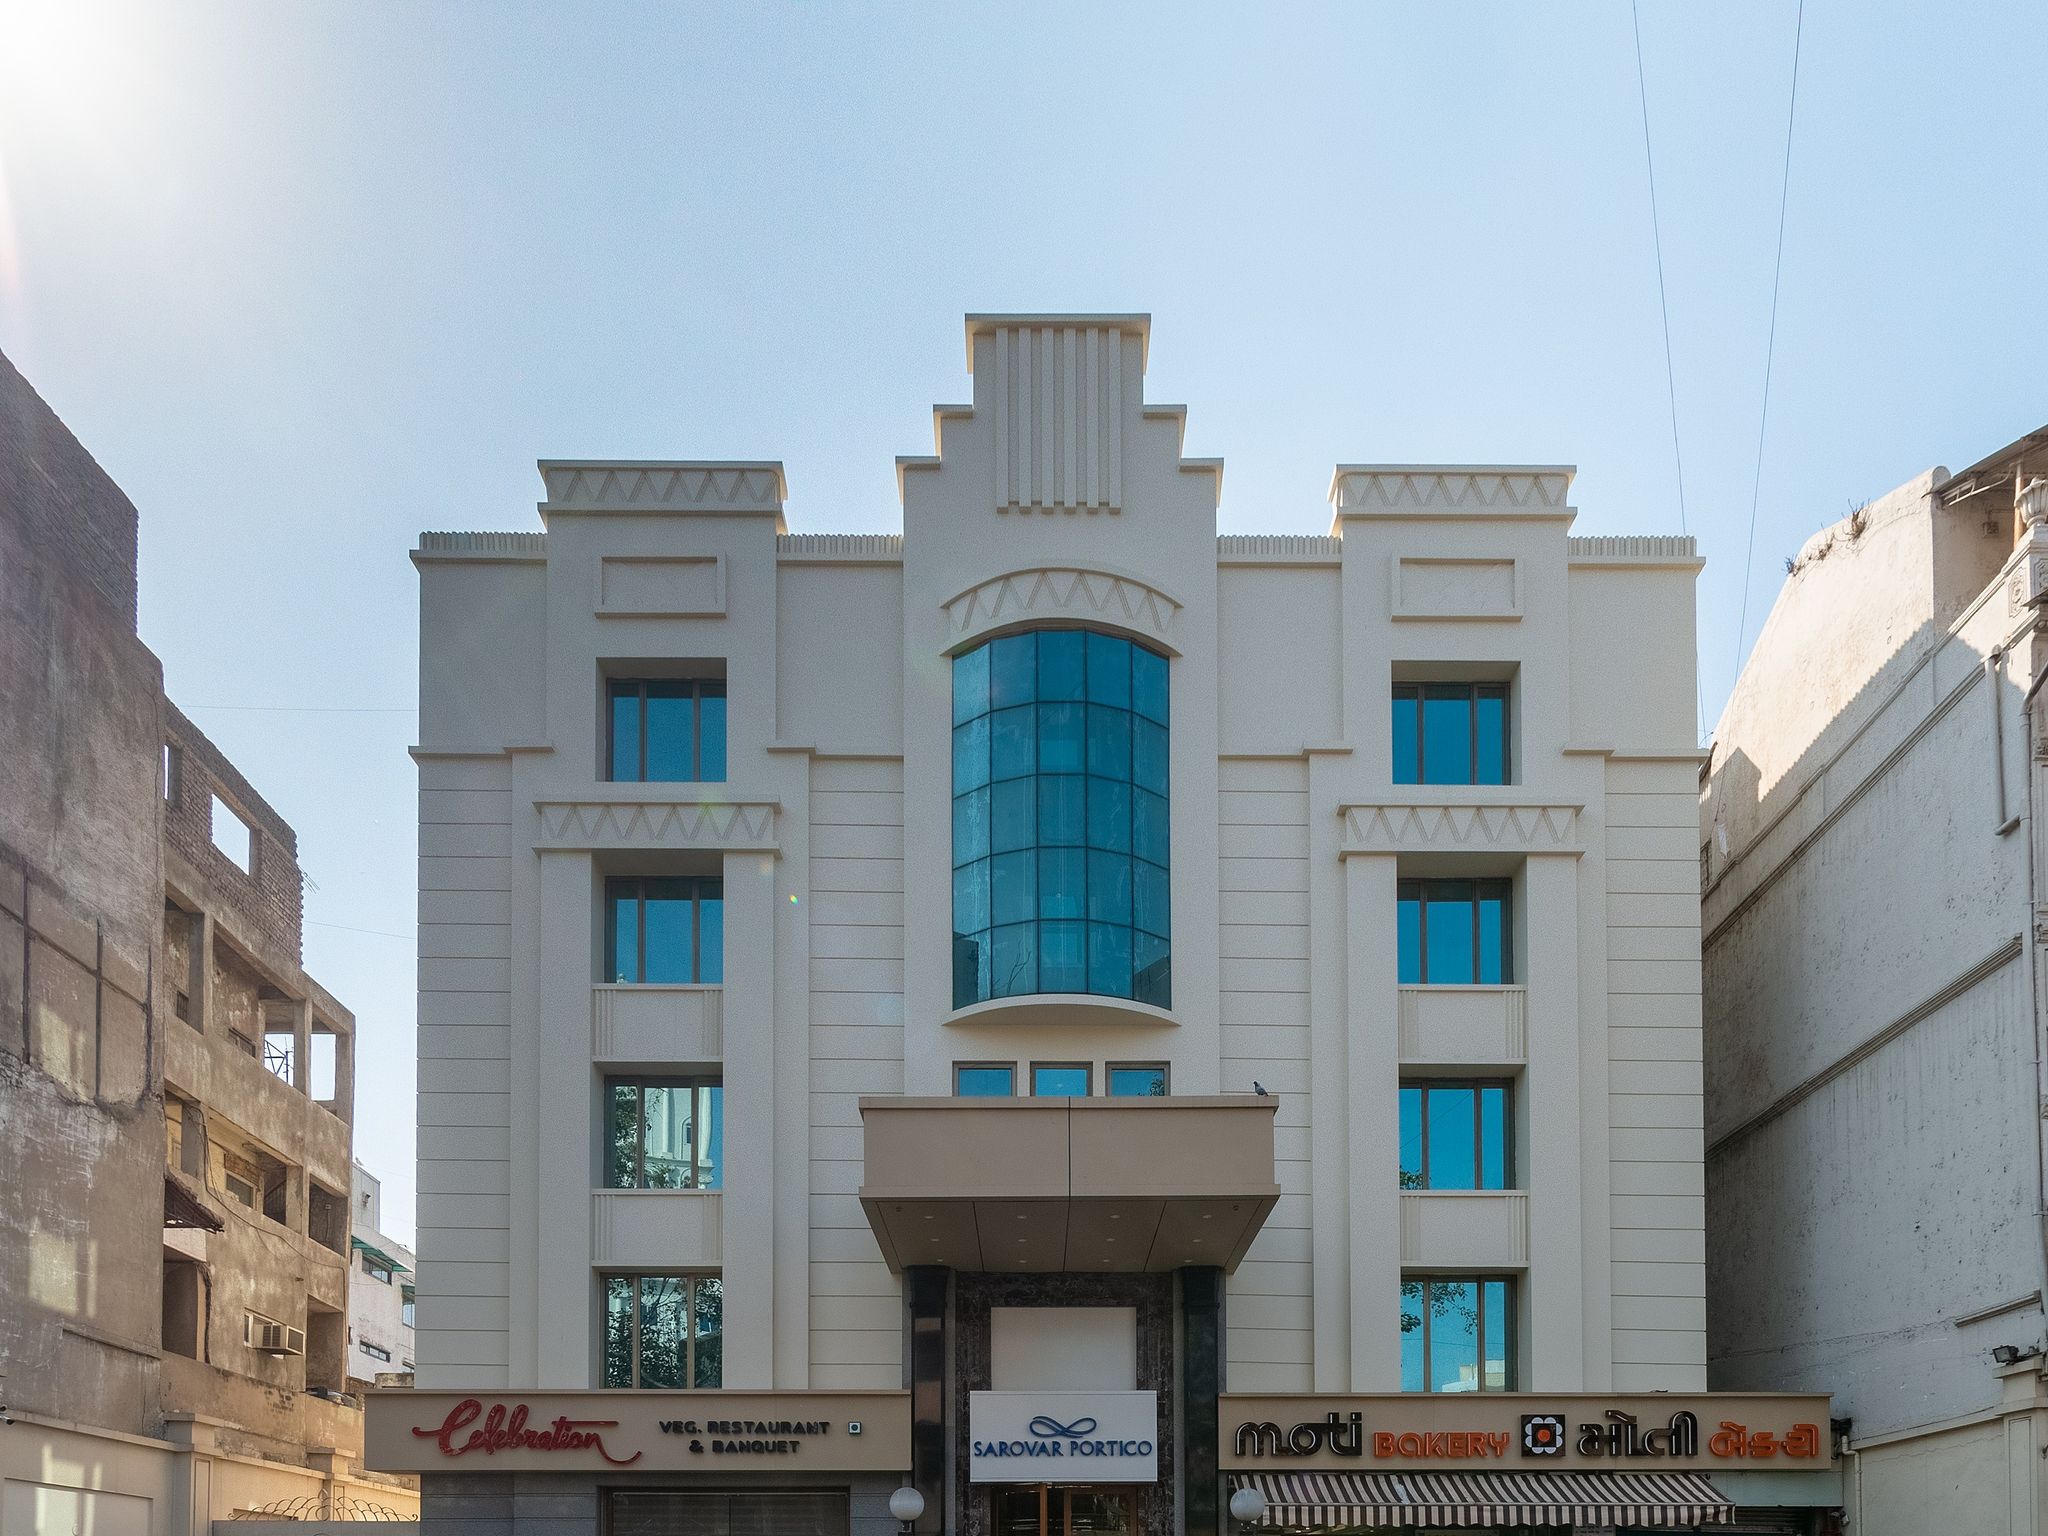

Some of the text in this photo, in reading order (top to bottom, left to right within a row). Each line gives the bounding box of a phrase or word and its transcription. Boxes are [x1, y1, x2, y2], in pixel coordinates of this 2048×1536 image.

[411, 1398, 642, 1465] Celebration
[658, 1420, 831, 1436] VEG. RESTAURANT
[1234, 1411, 1510, 1457] moti BAKERY
[1576, 1409, 1699, 1458] મોતી
[688, 1439, 801, 1455] & BANQUET
[974, 1440, 1153, 1457] SAROVAR PORTICO
